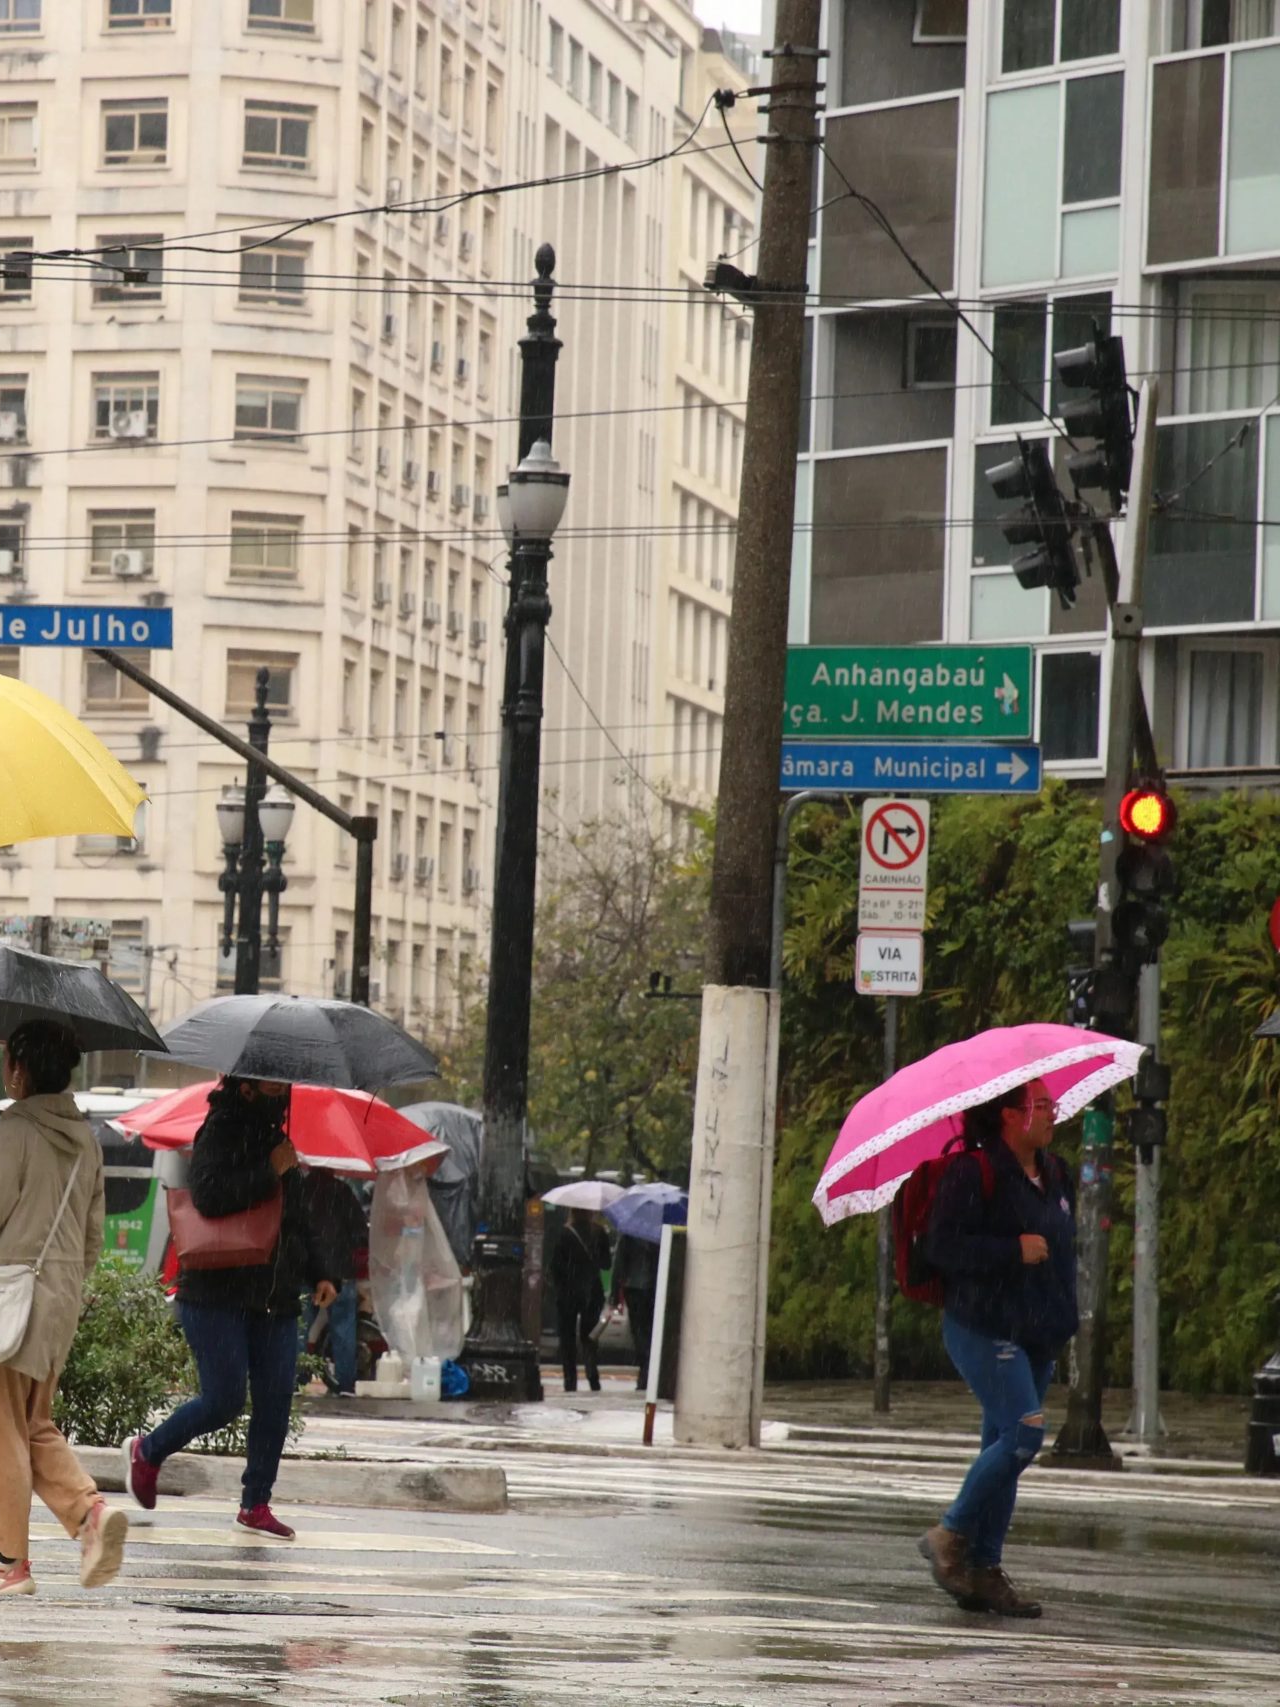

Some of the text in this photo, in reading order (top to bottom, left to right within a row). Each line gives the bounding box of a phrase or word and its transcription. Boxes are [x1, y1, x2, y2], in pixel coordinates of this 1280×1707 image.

[40, 611, 150, 642] Julho
[811, 656, 985, 694] Anhangabaú
[841, 699, 865, 723] J.
[876, 700, 984, 724] Mendes
[782, 754, 986, 782] âmara Municipal
[878, 946, 902, 960] VIA
